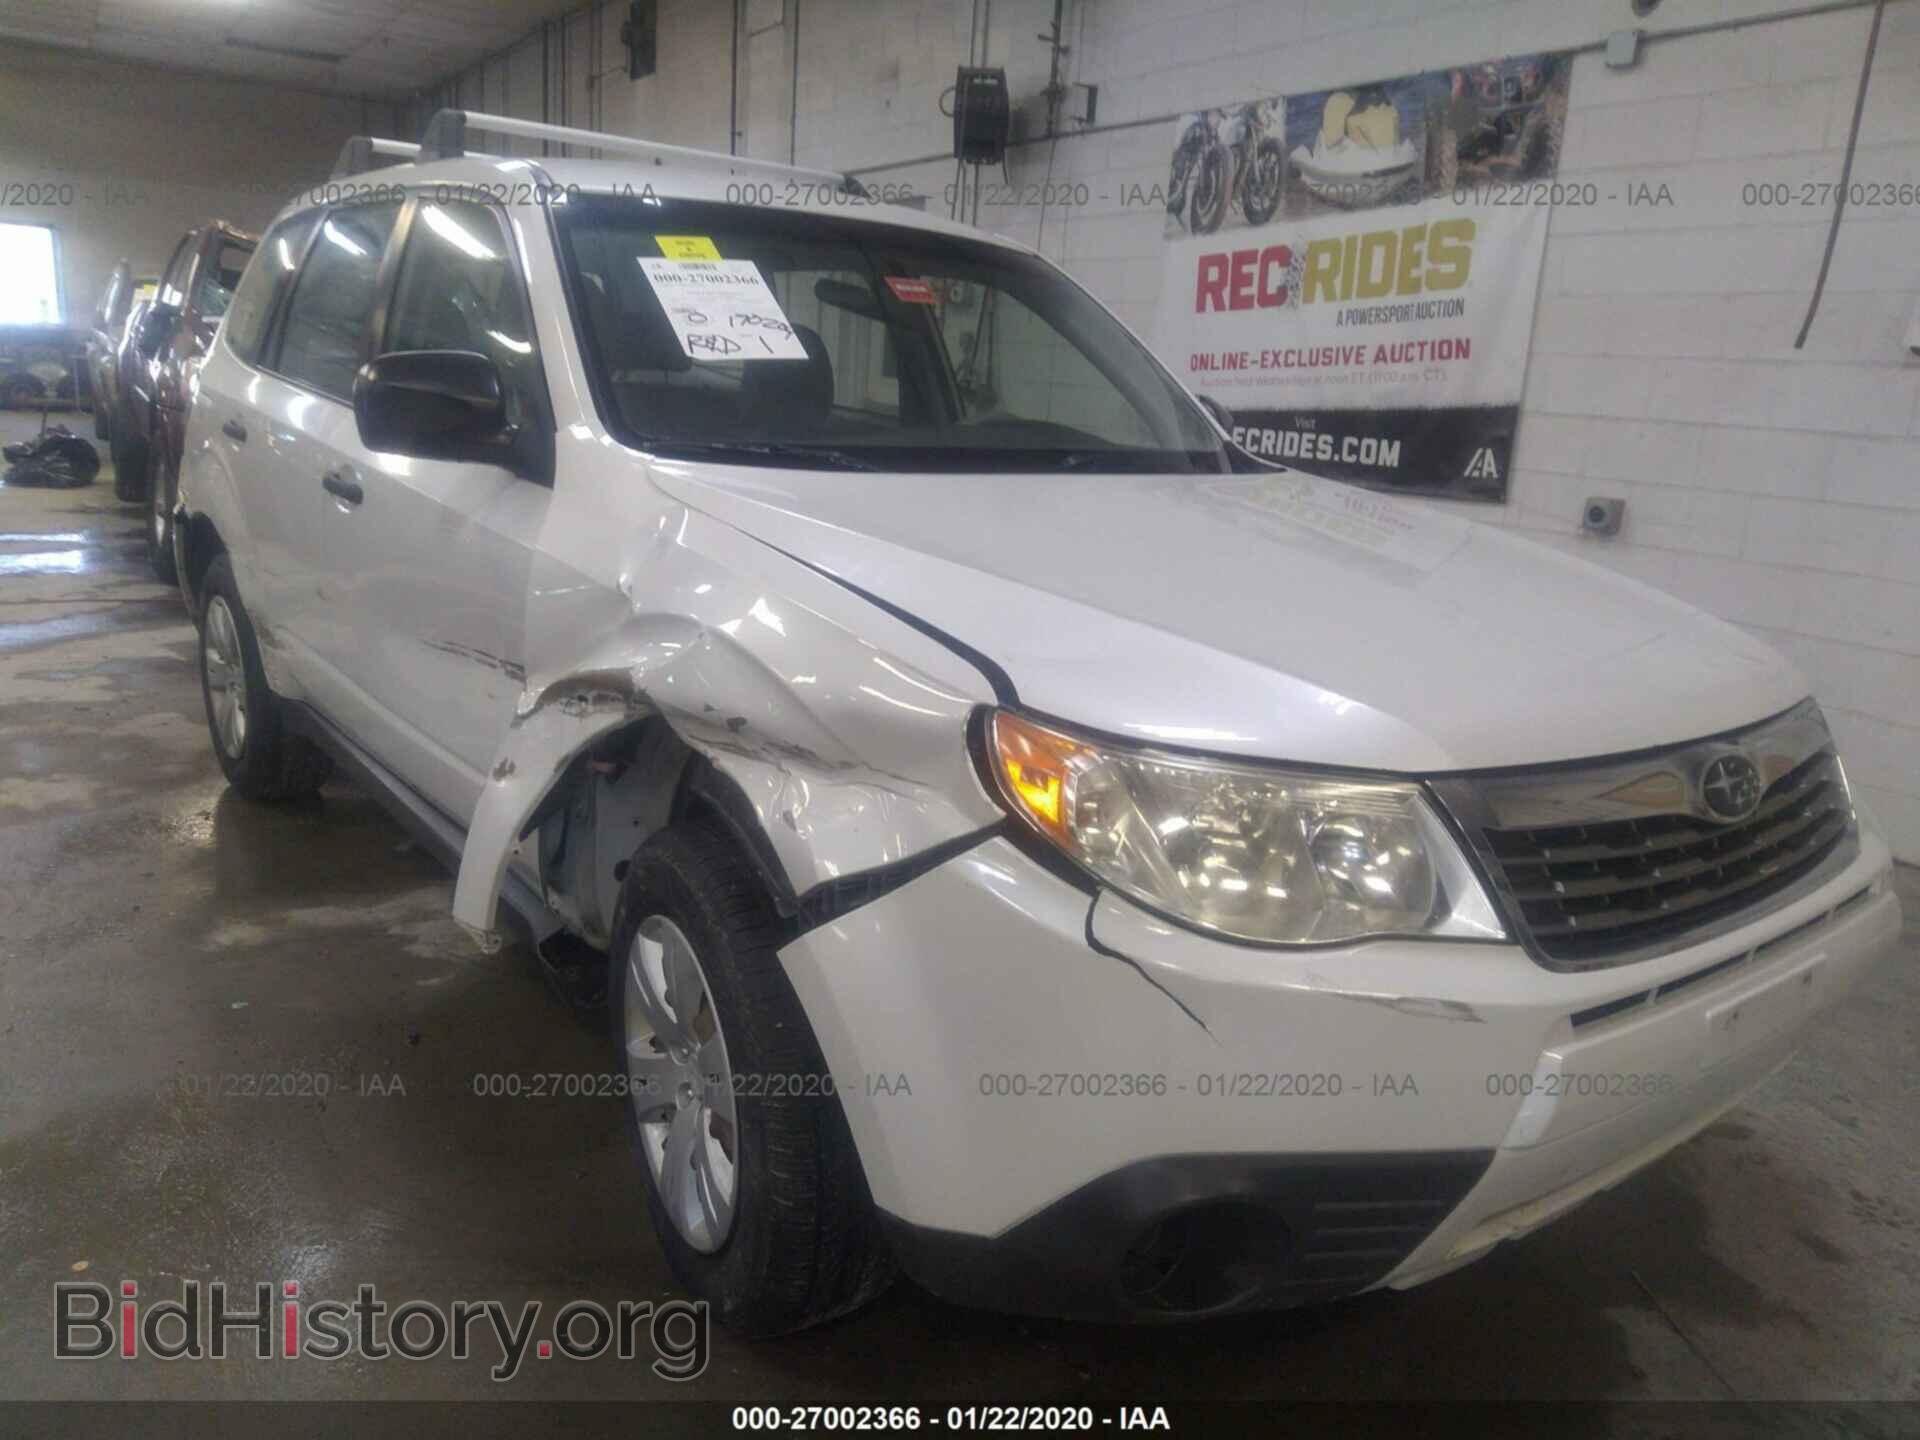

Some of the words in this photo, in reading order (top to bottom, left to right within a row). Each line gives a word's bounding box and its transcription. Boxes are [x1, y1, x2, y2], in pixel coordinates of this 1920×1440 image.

[1195, 244, 1293, 315] REC
[1301, 217, 1476, 304] RIDES
[1335, 309, 1344, 327] A
[1345, 303, 1415, 325] POWERSPORT
[1415, 297, 1465, 322] AUCTION
[1190, 345, 1367, 372] ONLINE-EXCLUSIVE
[1373, 338, 1471, 366] AUCTION
[1231, 426, 1401, 468] ECRIDES.COM
